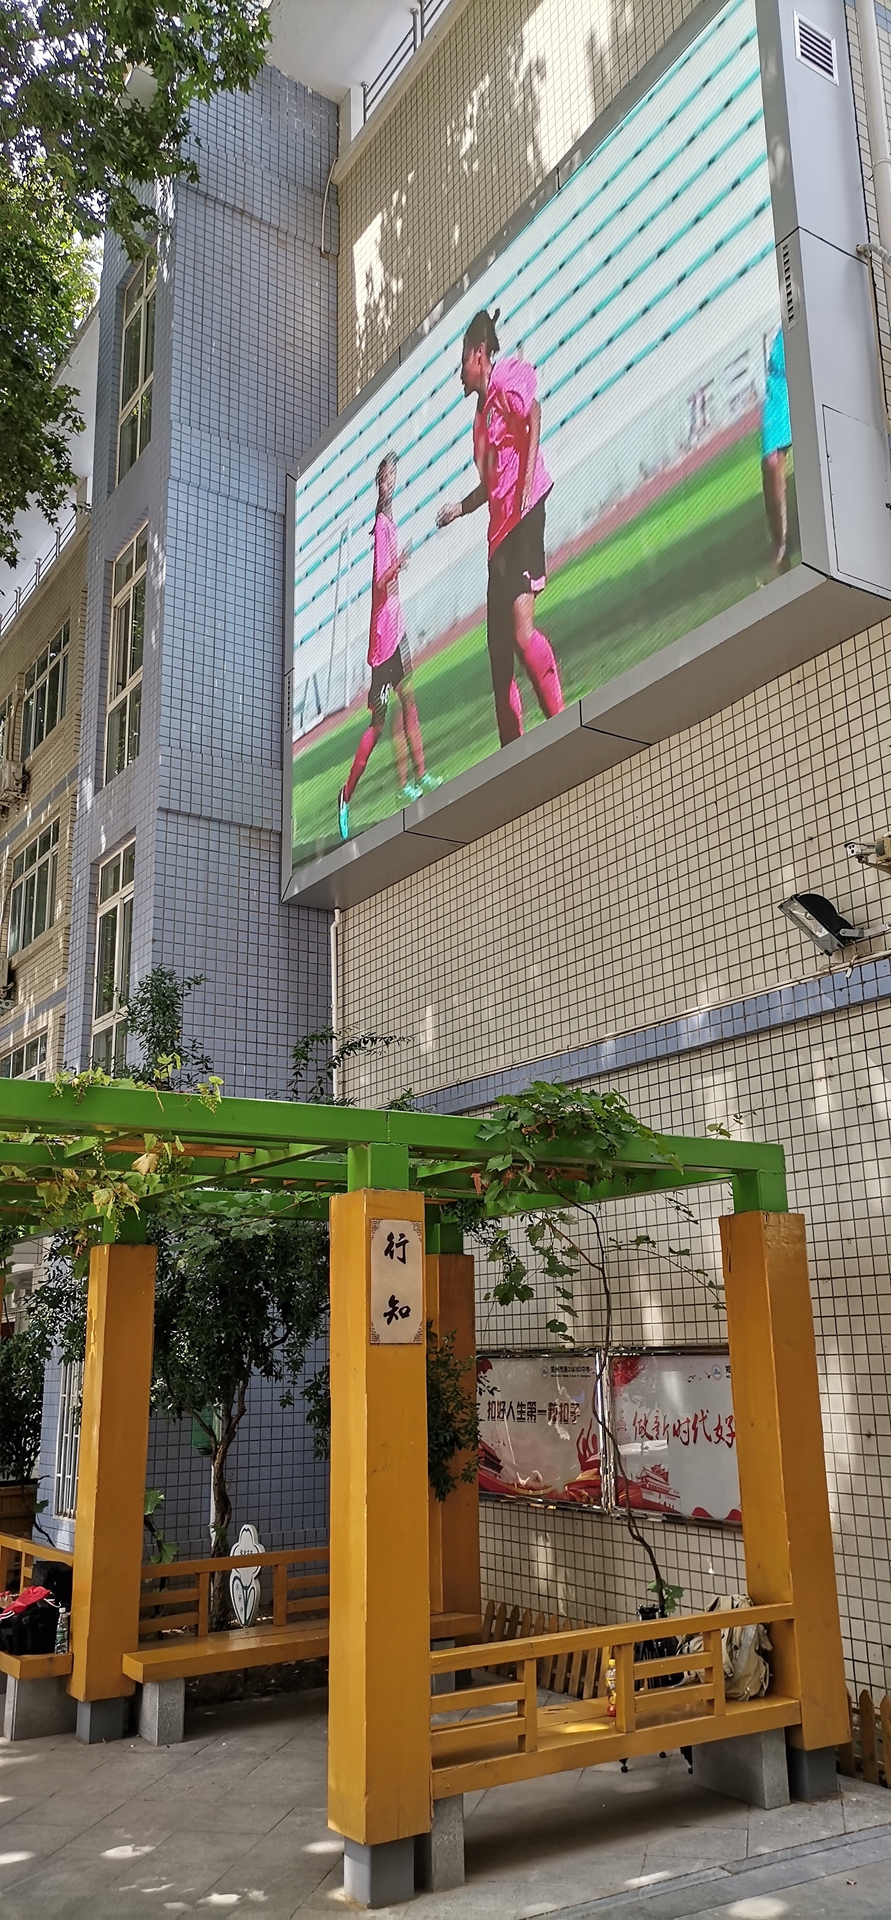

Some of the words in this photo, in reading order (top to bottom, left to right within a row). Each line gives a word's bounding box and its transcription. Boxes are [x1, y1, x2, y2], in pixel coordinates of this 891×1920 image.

[383, 1231, 411, 1326] 行知
[487, 1401, 580, 1424] 扣好人生第一粒扣子
[633, 1409, 735, 1448] 做新时代好
